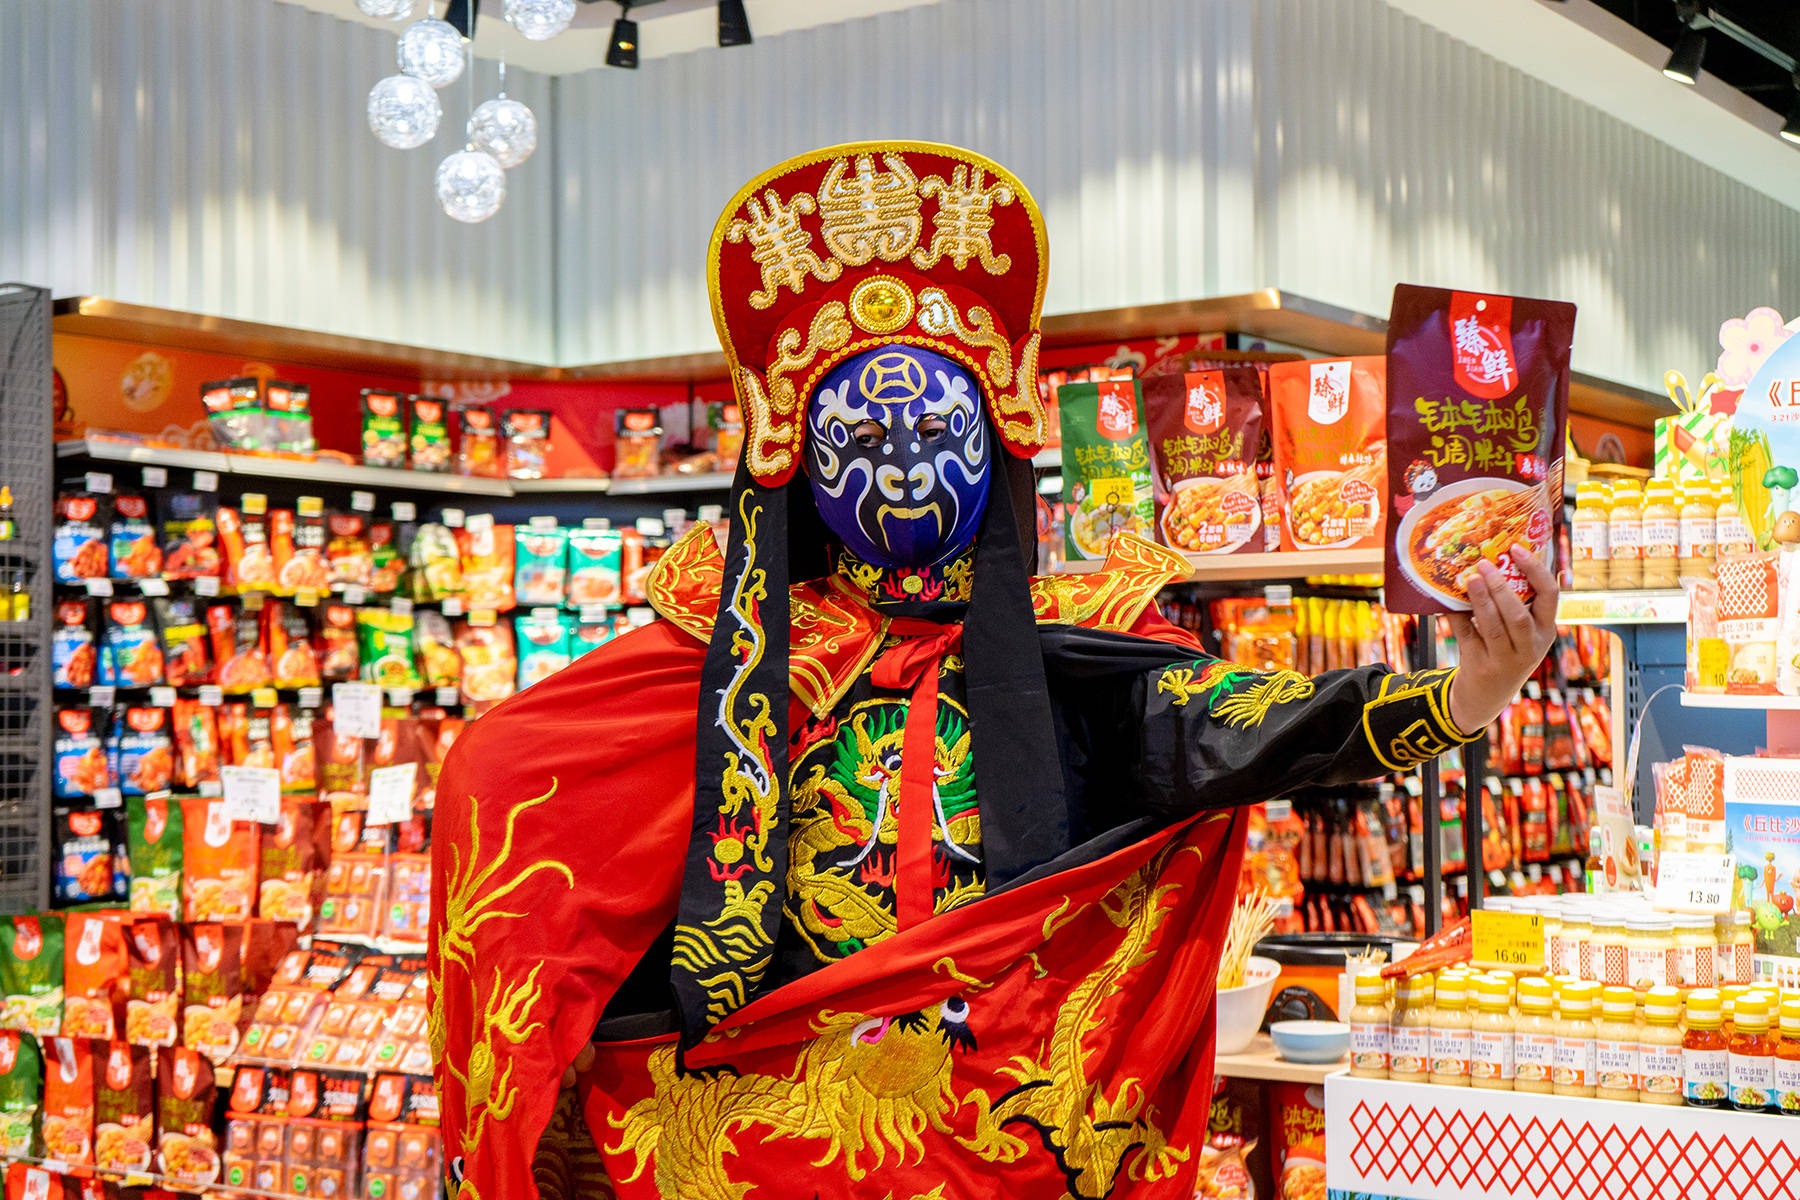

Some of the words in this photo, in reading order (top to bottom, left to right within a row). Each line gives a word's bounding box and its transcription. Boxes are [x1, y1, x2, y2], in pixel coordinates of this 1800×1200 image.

[1454, 315, 1514, 391] 臻鲜
[1688, 889, 1720, 905] 13.80
[1495, 948, 1527, 965] 16.90
